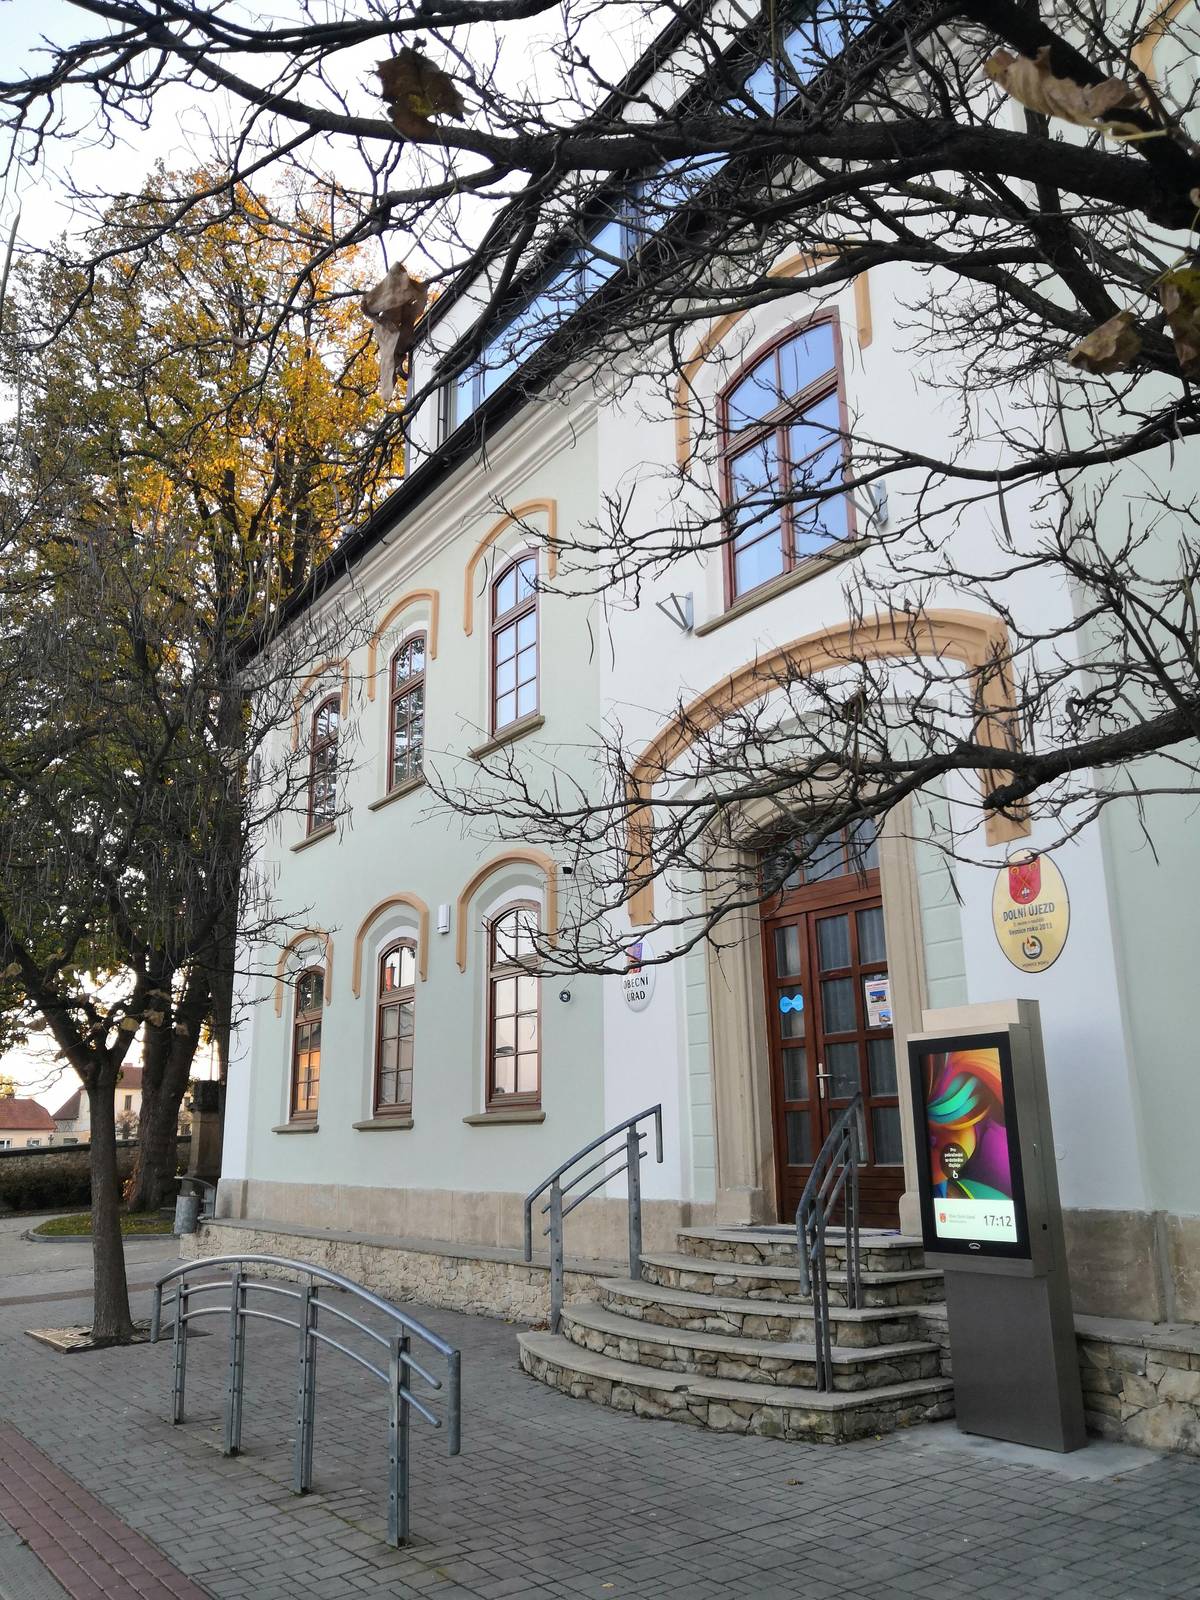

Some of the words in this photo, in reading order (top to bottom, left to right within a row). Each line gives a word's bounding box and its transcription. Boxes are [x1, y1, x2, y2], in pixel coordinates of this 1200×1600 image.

[1003, 906, 1027, 921] DOLNÍ
[1028, 902, 1055, 916] ÚJEZD
[623, 974, 649, 990] OBECNÍ
[983, 1215, 1013, 1227] 17:12
